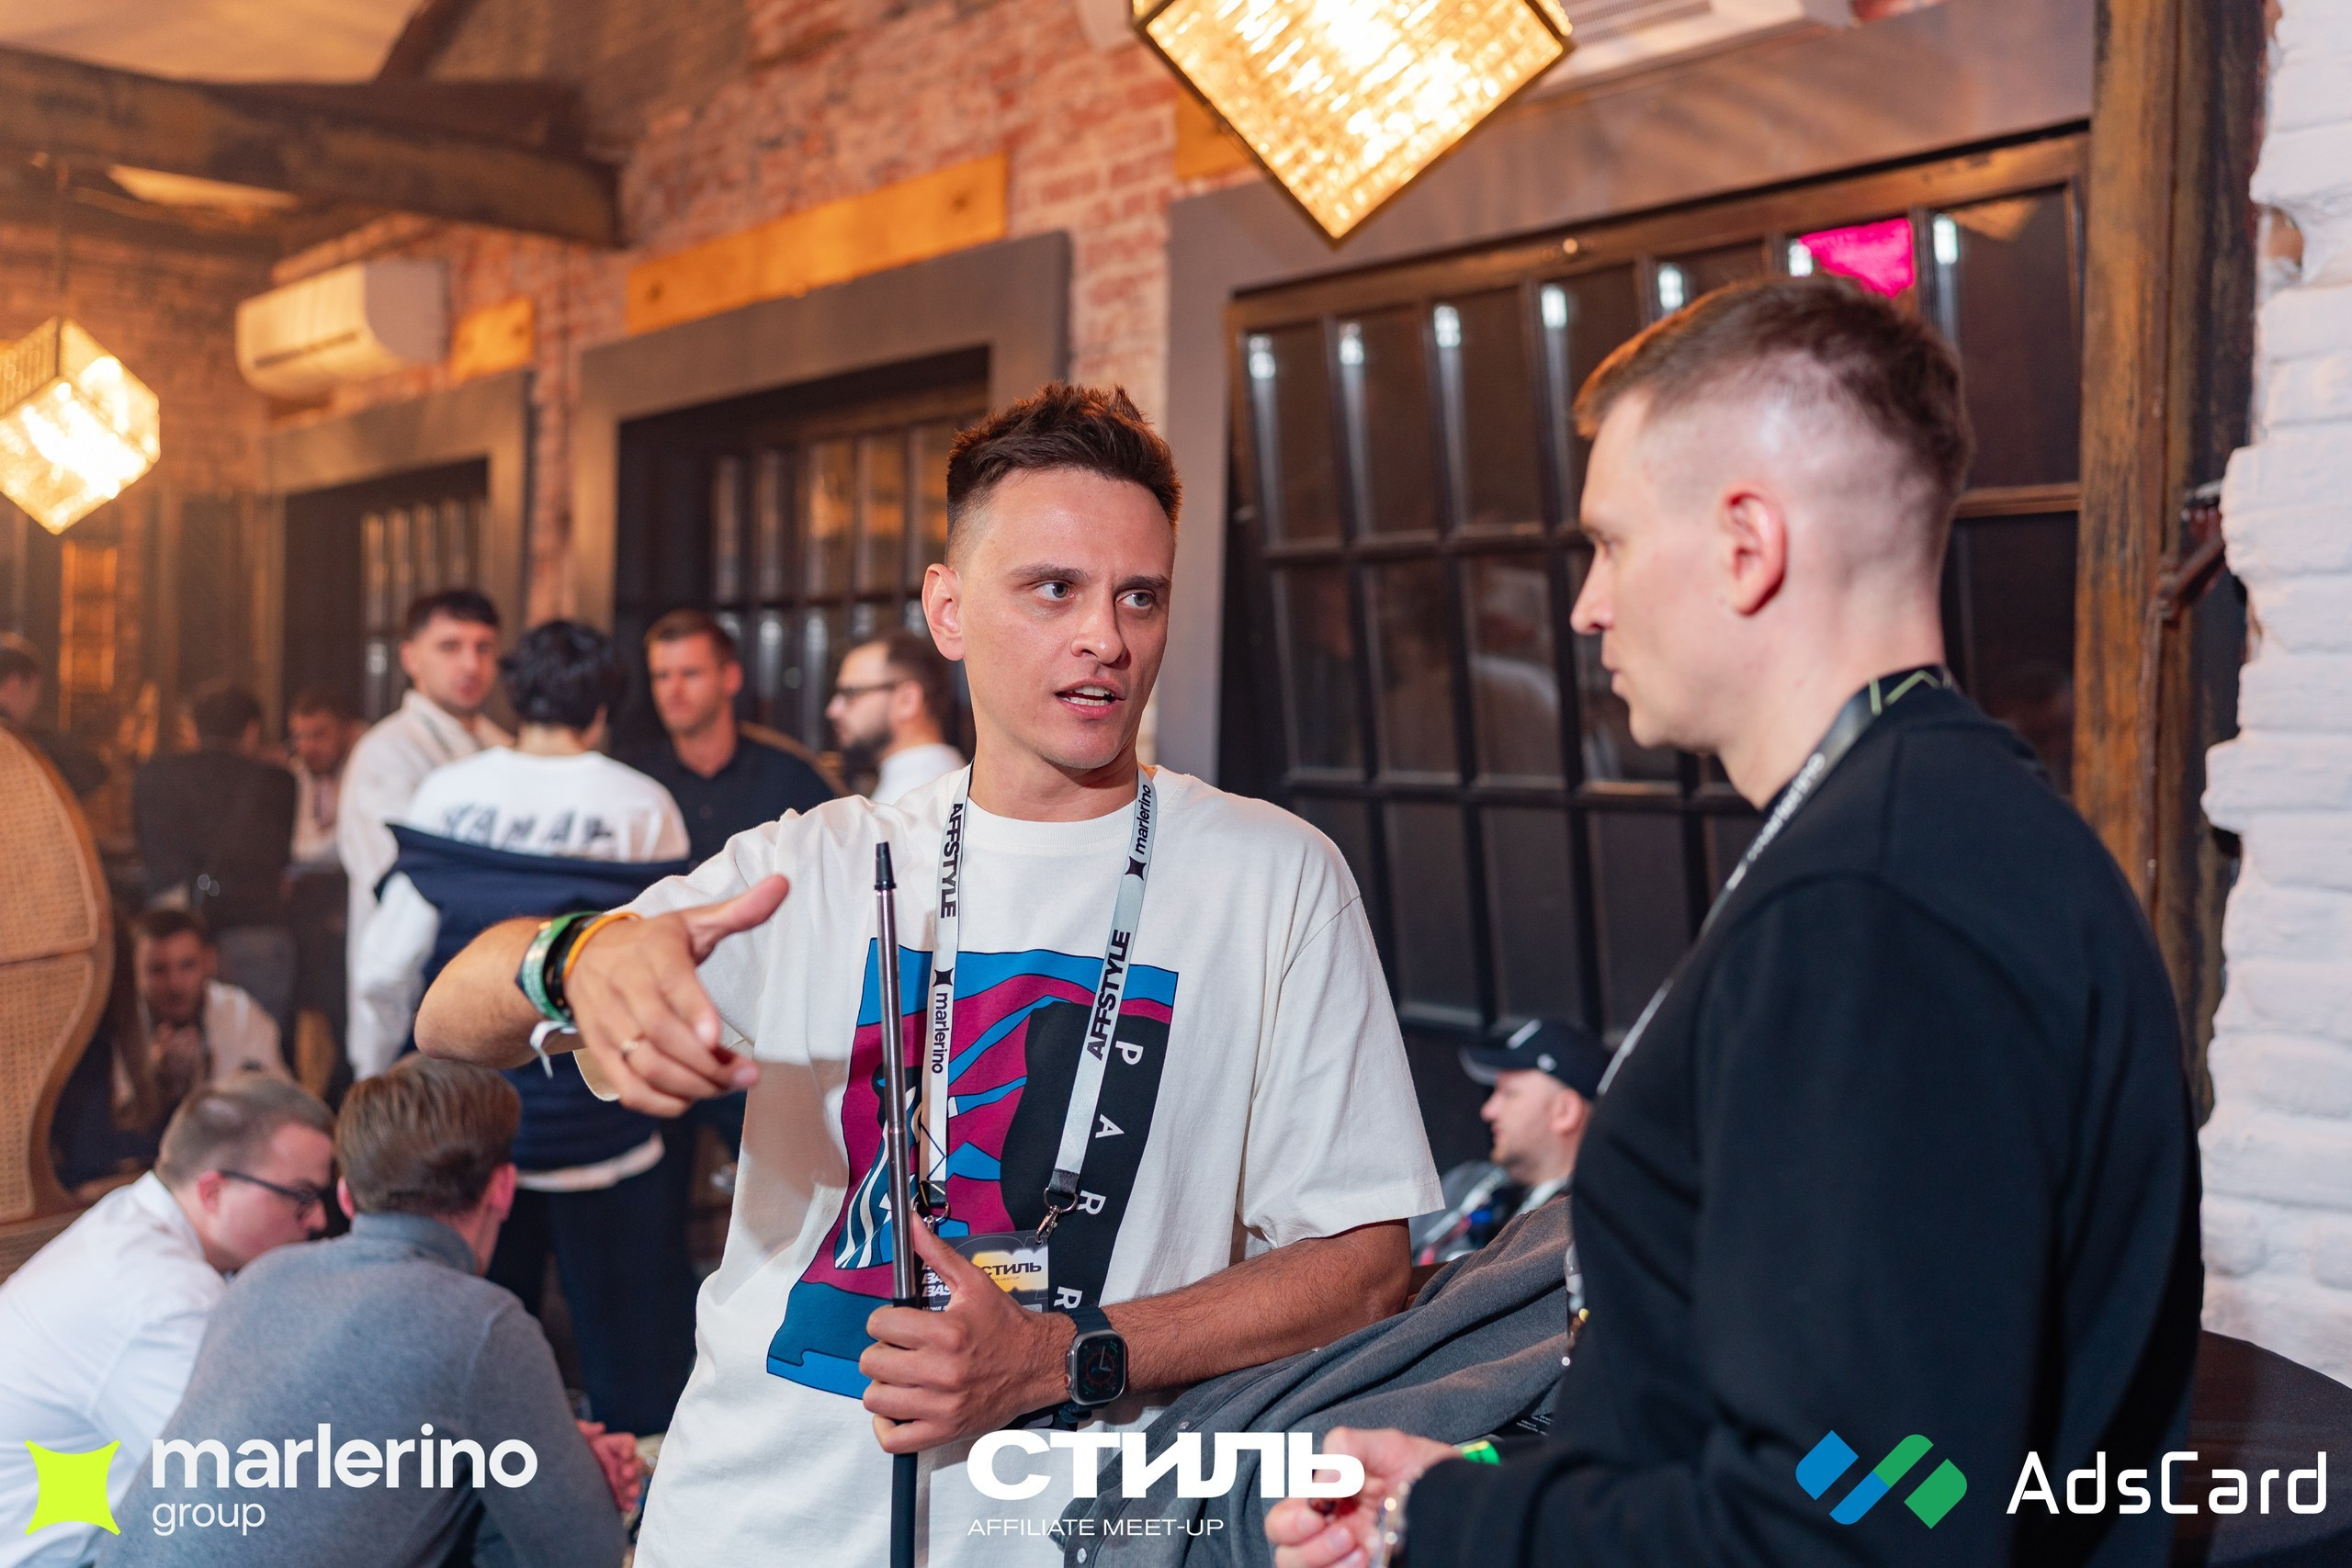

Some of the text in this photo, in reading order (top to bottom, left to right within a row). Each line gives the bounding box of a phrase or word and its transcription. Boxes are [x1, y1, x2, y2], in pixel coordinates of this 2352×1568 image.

[1135, 784, 1151, 854] marlerino
[940, 803, 964, 919] AFFSTYLE
[931, 992, 948, 1075] marlerino
[1086, 930, 1131, 1061] AFFSTYLE
[982, 1262, 1042, 1276] СТИЛЬ
